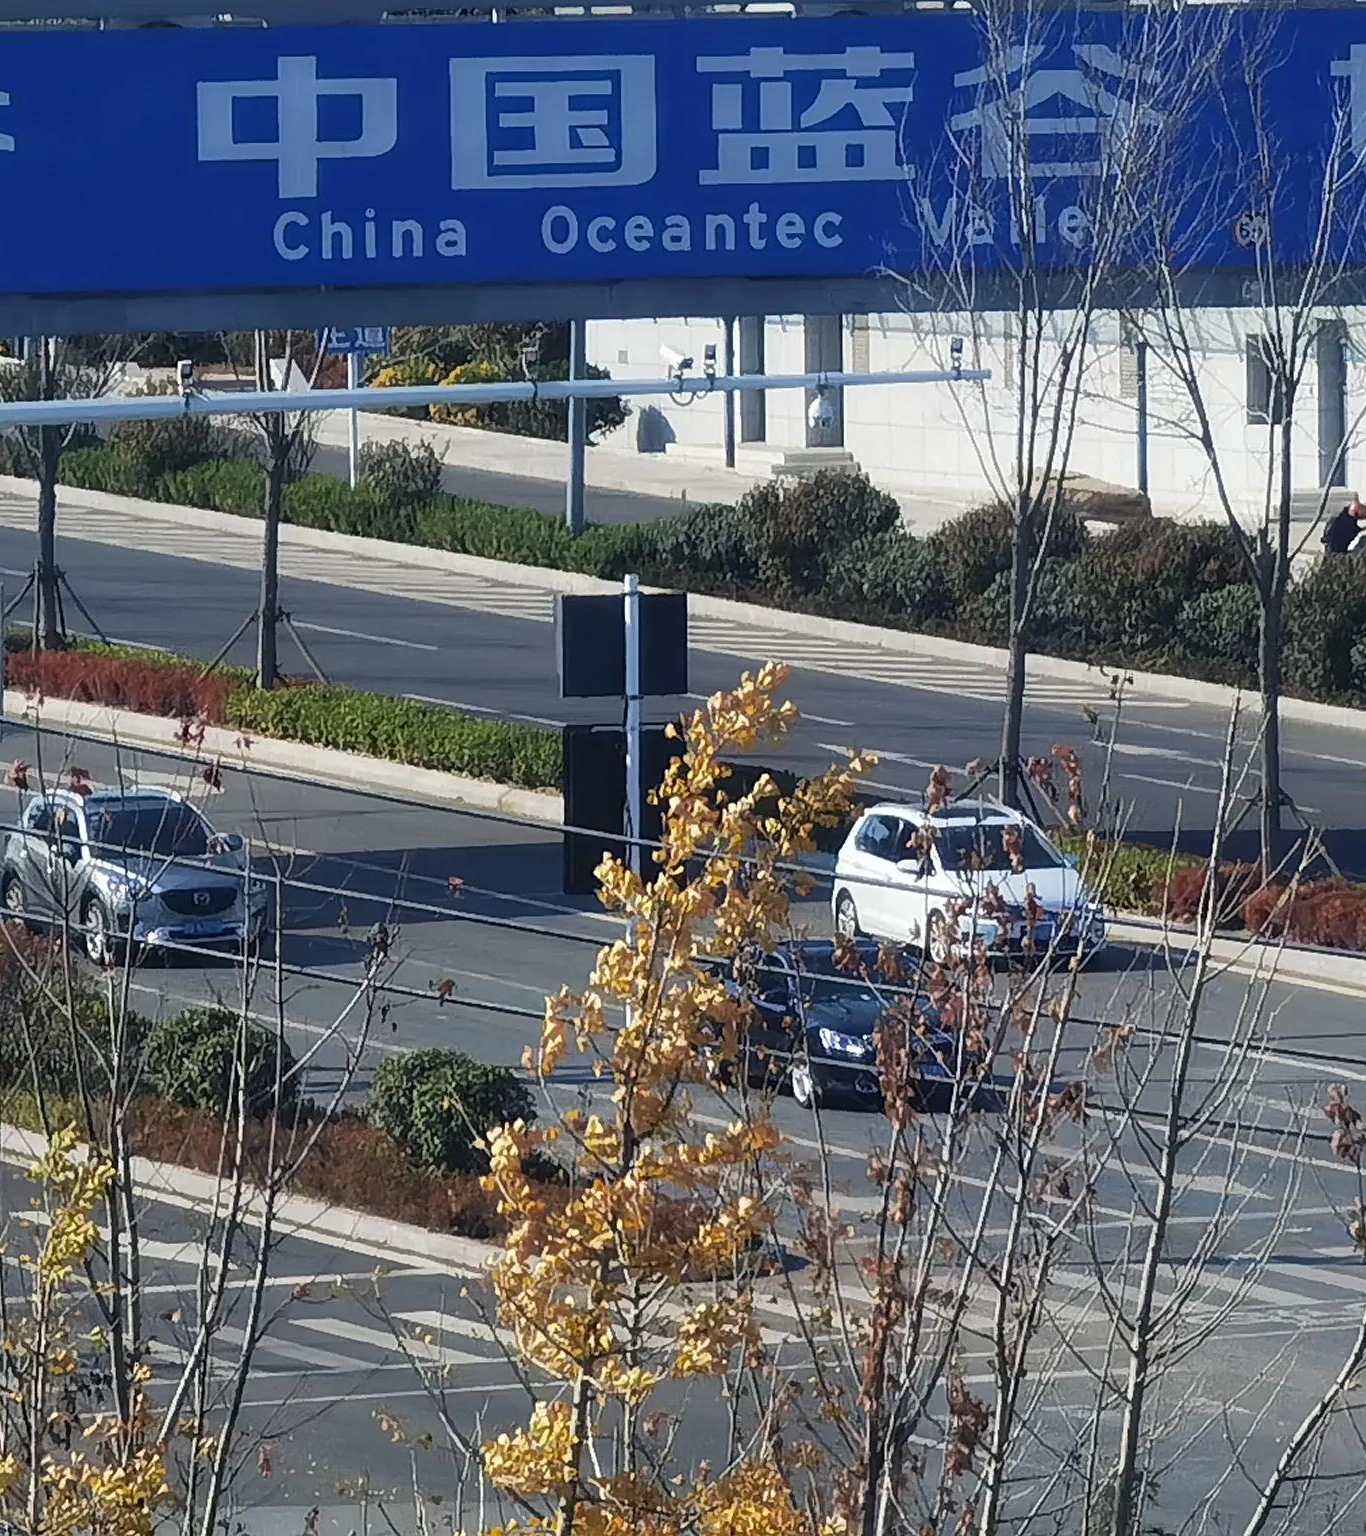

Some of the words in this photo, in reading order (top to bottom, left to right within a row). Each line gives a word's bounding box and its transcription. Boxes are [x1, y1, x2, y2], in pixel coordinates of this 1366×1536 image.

[196, 44, 1168, 199] 中国蓝谷
[272, 208, 467, 261] China
[541, 201, 844, 255] Oceantec
[921, 195, 1117, 250] Valle
